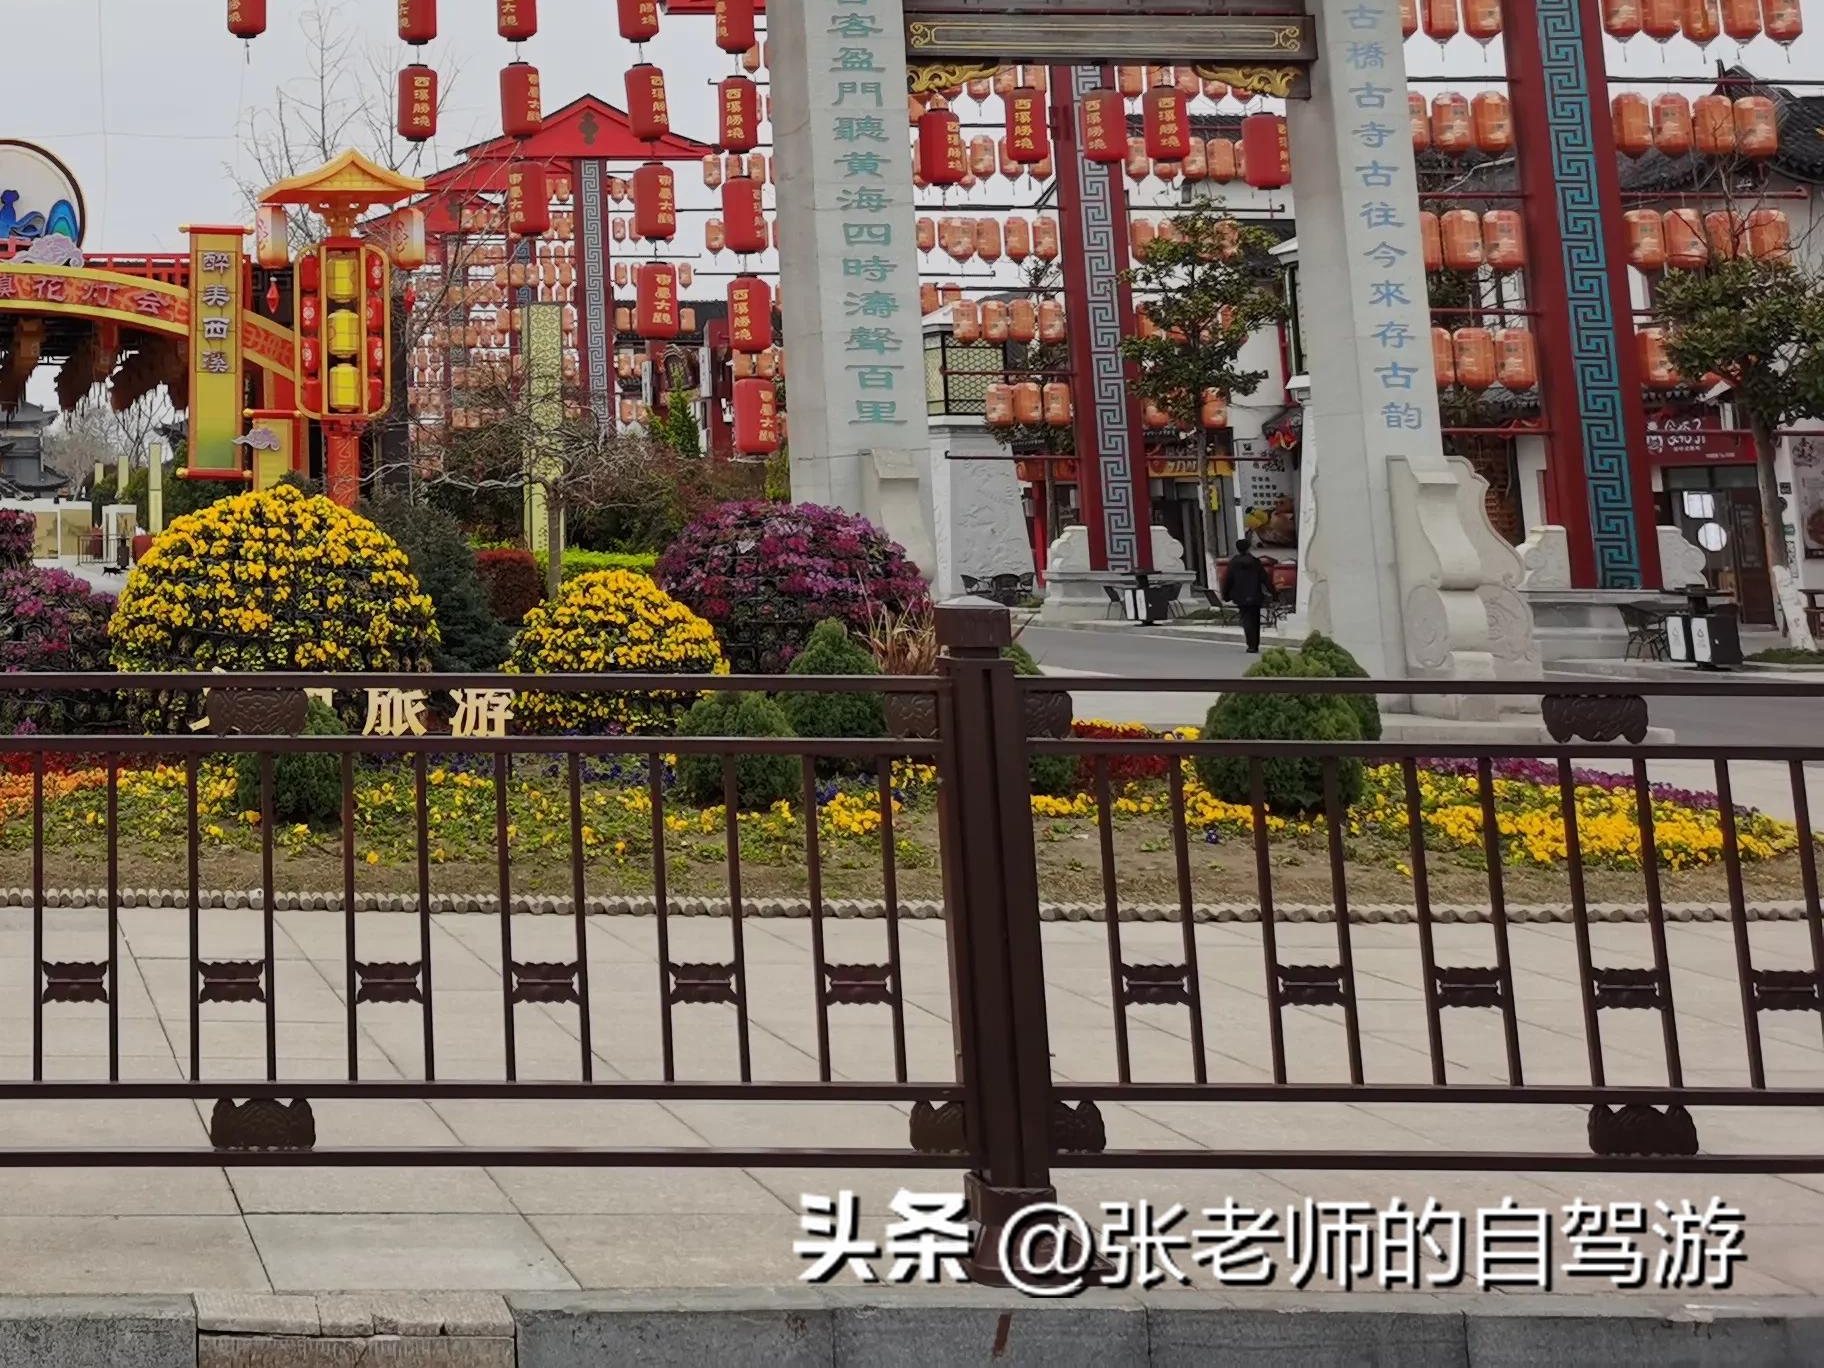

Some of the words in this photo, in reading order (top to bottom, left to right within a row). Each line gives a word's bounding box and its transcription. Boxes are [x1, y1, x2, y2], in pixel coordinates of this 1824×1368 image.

[201, 251, 232, 373] 醉美西溪
[304, 688, 516, 737] 旅游
